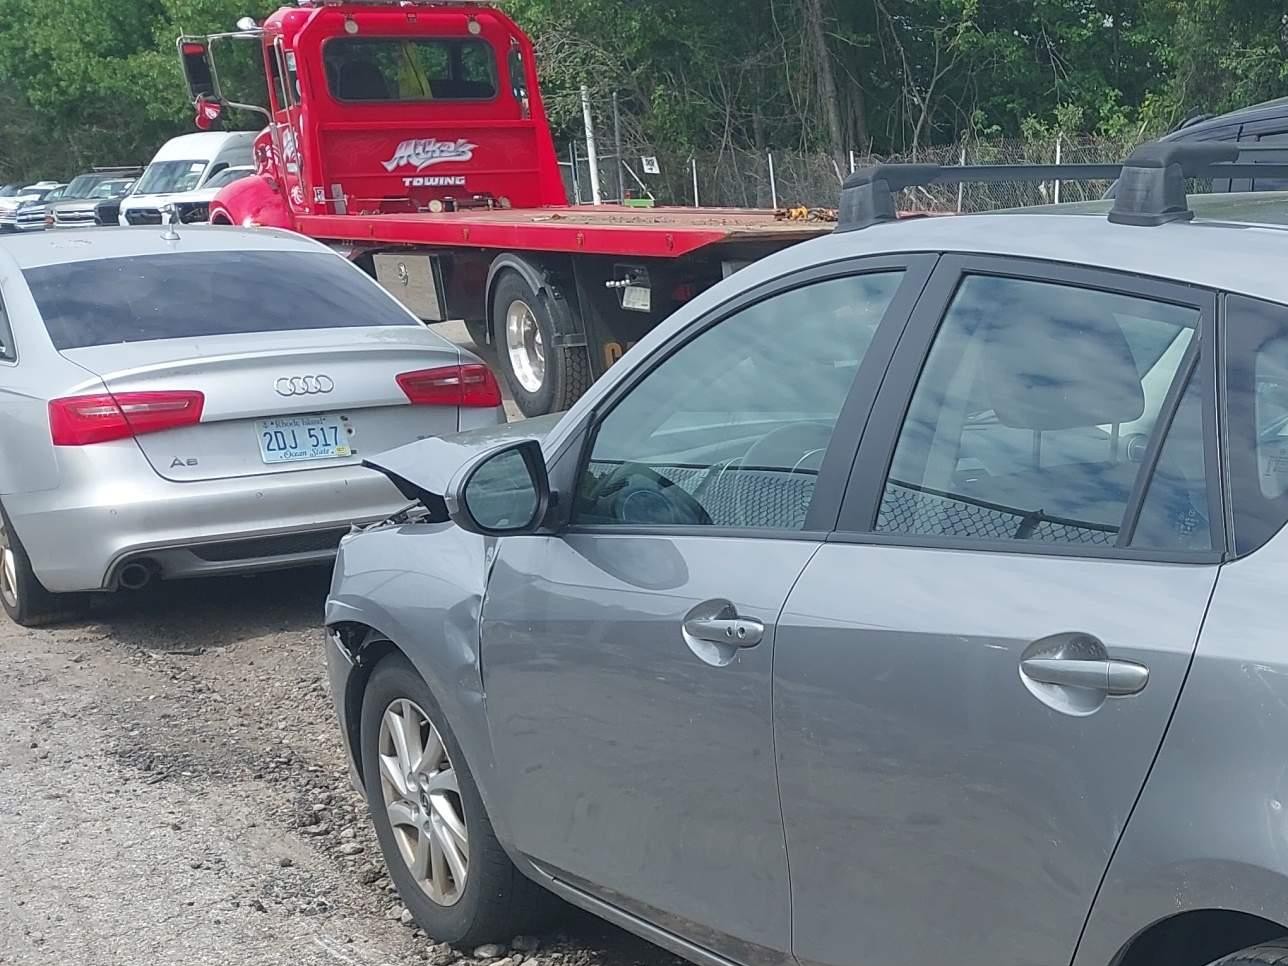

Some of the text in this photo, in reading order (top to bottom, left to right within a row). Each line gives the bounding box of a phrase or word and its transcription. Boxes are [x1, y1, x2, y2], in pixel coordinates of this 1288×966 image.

[402, 176, 466, 187] TOWING
[263, 426, 338, 452] 2DJ 517
[284, 450, 307, 459] Ocean
[309, 448, 330, 457] State
